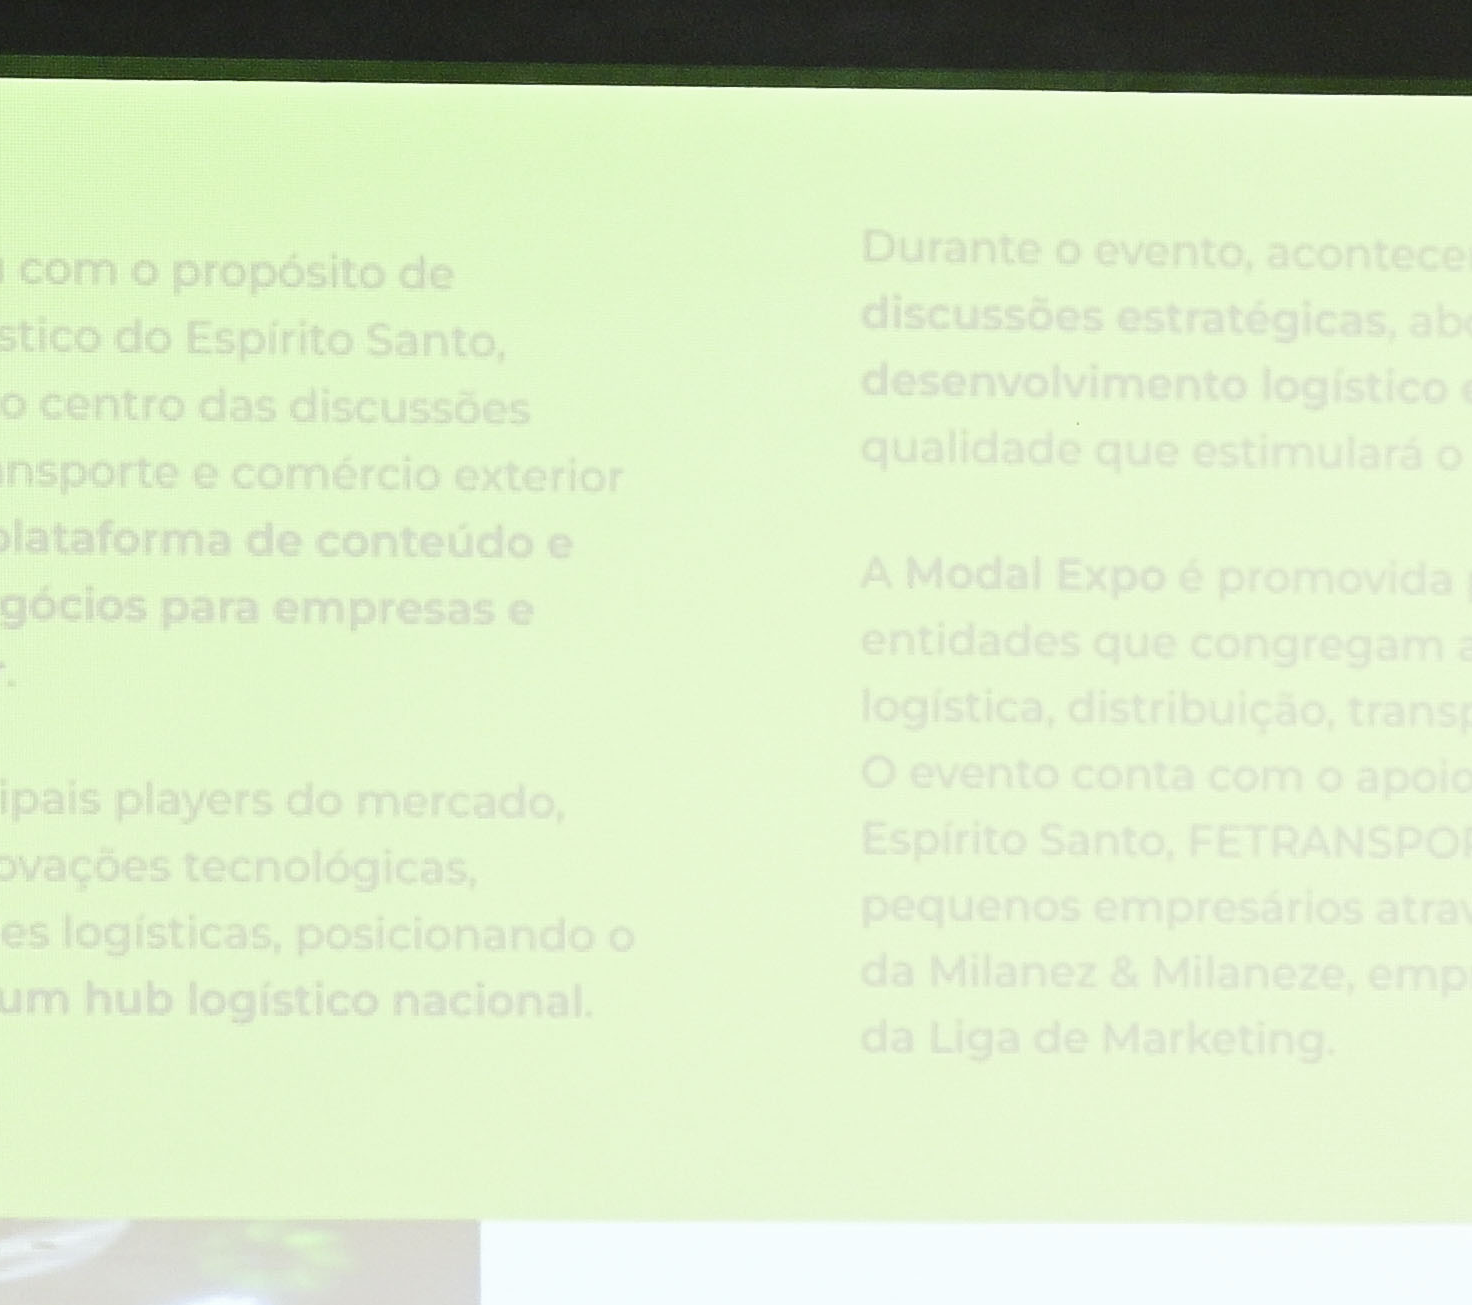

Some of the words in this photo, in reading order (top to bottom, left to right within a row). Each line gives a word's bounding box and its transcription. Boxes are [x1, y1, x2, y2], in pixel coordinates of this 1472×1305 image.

[861, 226, 1043, 266] Durante
[1054, 237, 1084, 267] o
[1093, 236, 1254, 272] evento,
[17, 255, 118, 287] com
[129, 258, 160, 288] o
[171, 252, 387, 296] propósito
[397, 254, 456, 292] de
[113, 318, 173, 355] do
[186, 319, 355, 363] Espírito
[366, 321, 507, 364] Santo,
[38, 389, 186, 423] centro
[197, 387, 278, 424] das
[288, 388, 532, 427] discussões
[859, 361, 1249, 403] desenvolvimento
[1261, 366, 1450, 413] logístico
[191, 461, 220, 491] e
[230, 455, 443, 492] comércio
[453, 456, 625, 495] exterior
[245, 521, 304, 558] de
[314, 523, 535, 560] conteúdo
[546, 532, 575, 561] e
[859, 554, 893, 589] A
[905, 554, 1043, 592] Modal
[1056, 555, 1168, 600] Expo
[1177, 558, 1205, 594] é
[1217, 559, 1455, 601] promovida
[160, 595, 260, 631] para
[272, 596, 496, 633] empresas
[507, 598, 536, 627] e
[114, 779, 275, 825] players
[284, 781, 344, 818] do
[356, 782, 567, 825] mercado,
[861, 819, 1029, 863] Espírito
[1039, 821, 1175, 862] Santo,
[183, 848, 478, 894] tecnológicas,
[62, 913, 282, 959] logísticas,
[295, 915, 597, 957] posicionando
[606, 923, 637, 954] o
[84, 979, 175, 1017] hub
[187, 980, 381, 1027] logístico
[392, 980, 593, 1020] nacional.
